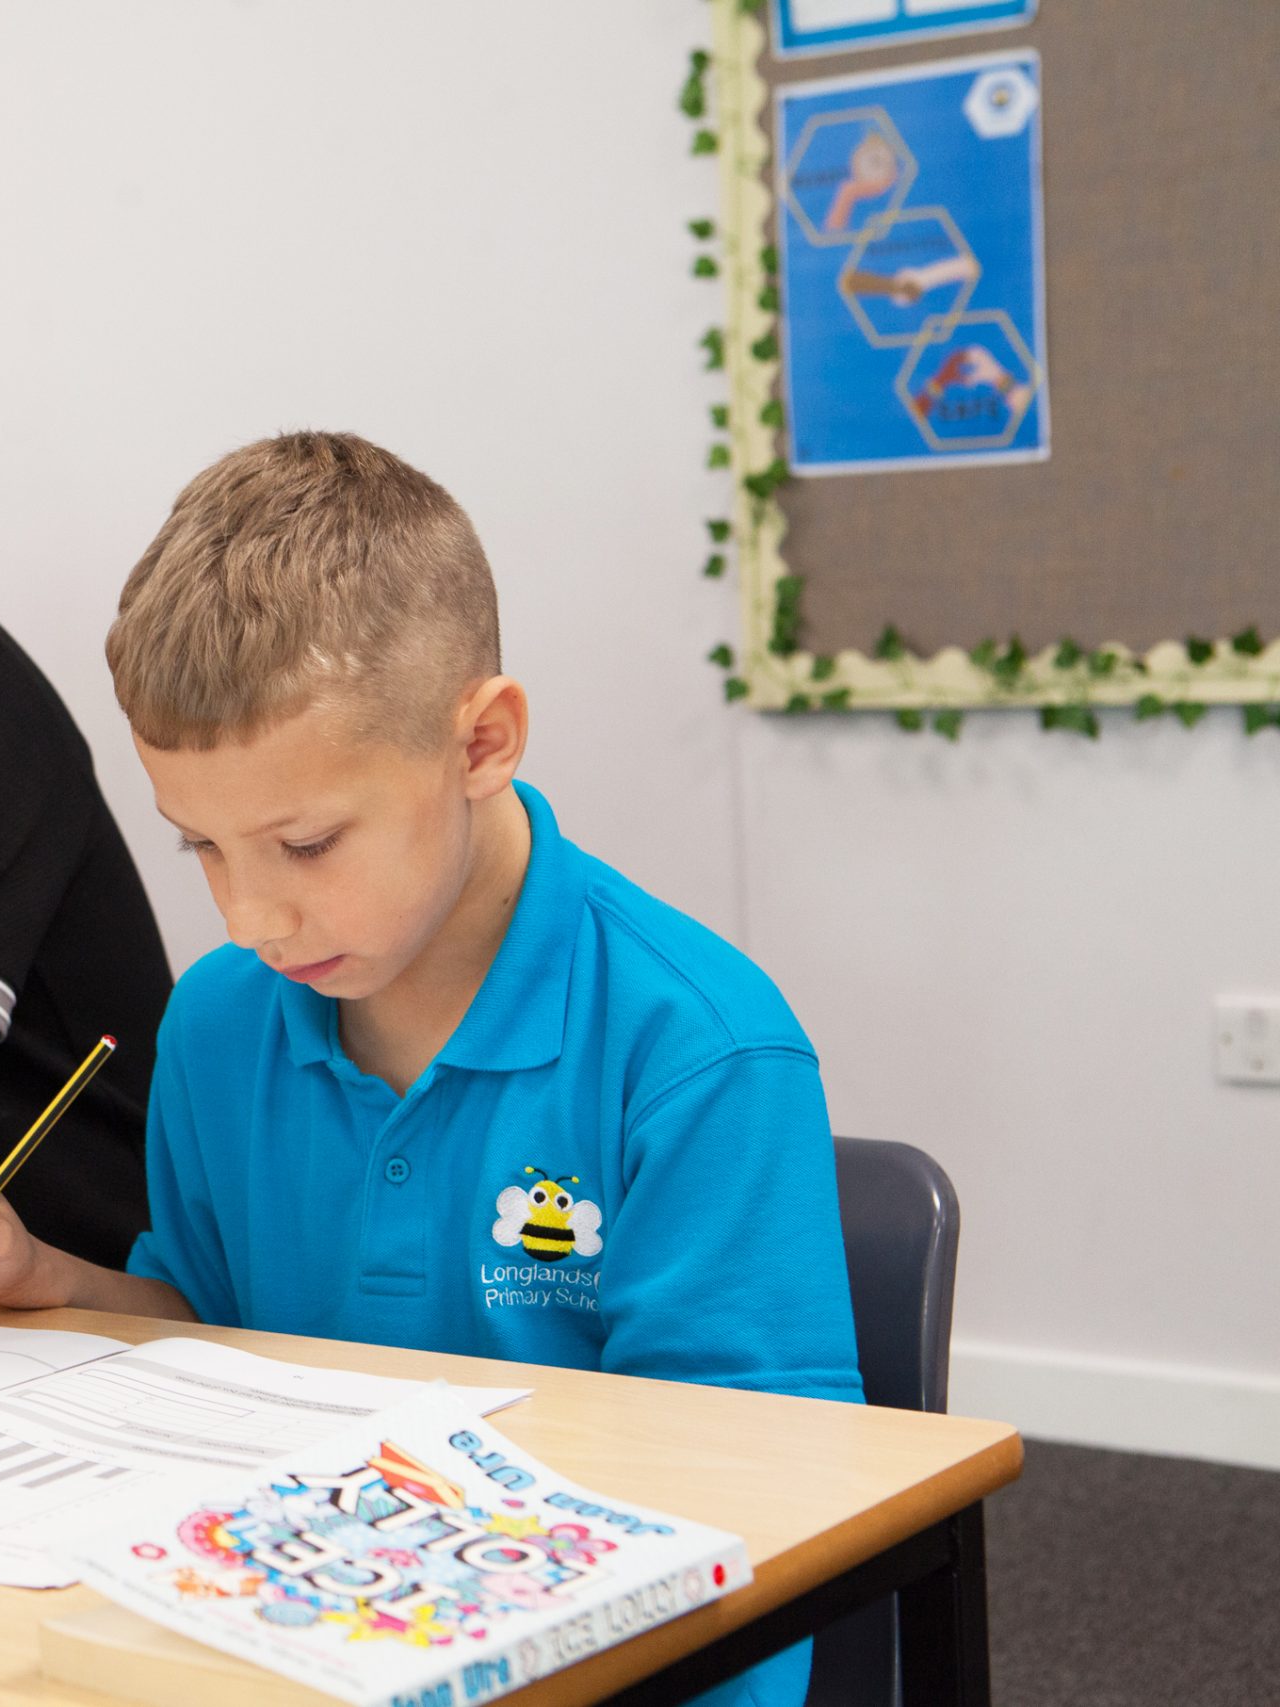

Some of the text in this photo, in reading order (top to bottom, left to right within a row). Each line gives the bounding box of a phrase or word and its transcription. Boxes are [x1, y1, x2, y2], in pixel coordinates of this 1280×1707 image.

[481, 1264, 593, 1287] Longlands
[485, 1287, 551, 1309] Primary
[448, 1430, 676, 1538] Jean Ure
[251, 1528, 462, 1621] ICE
[286, 1466, 614, 1597] LOLLY
